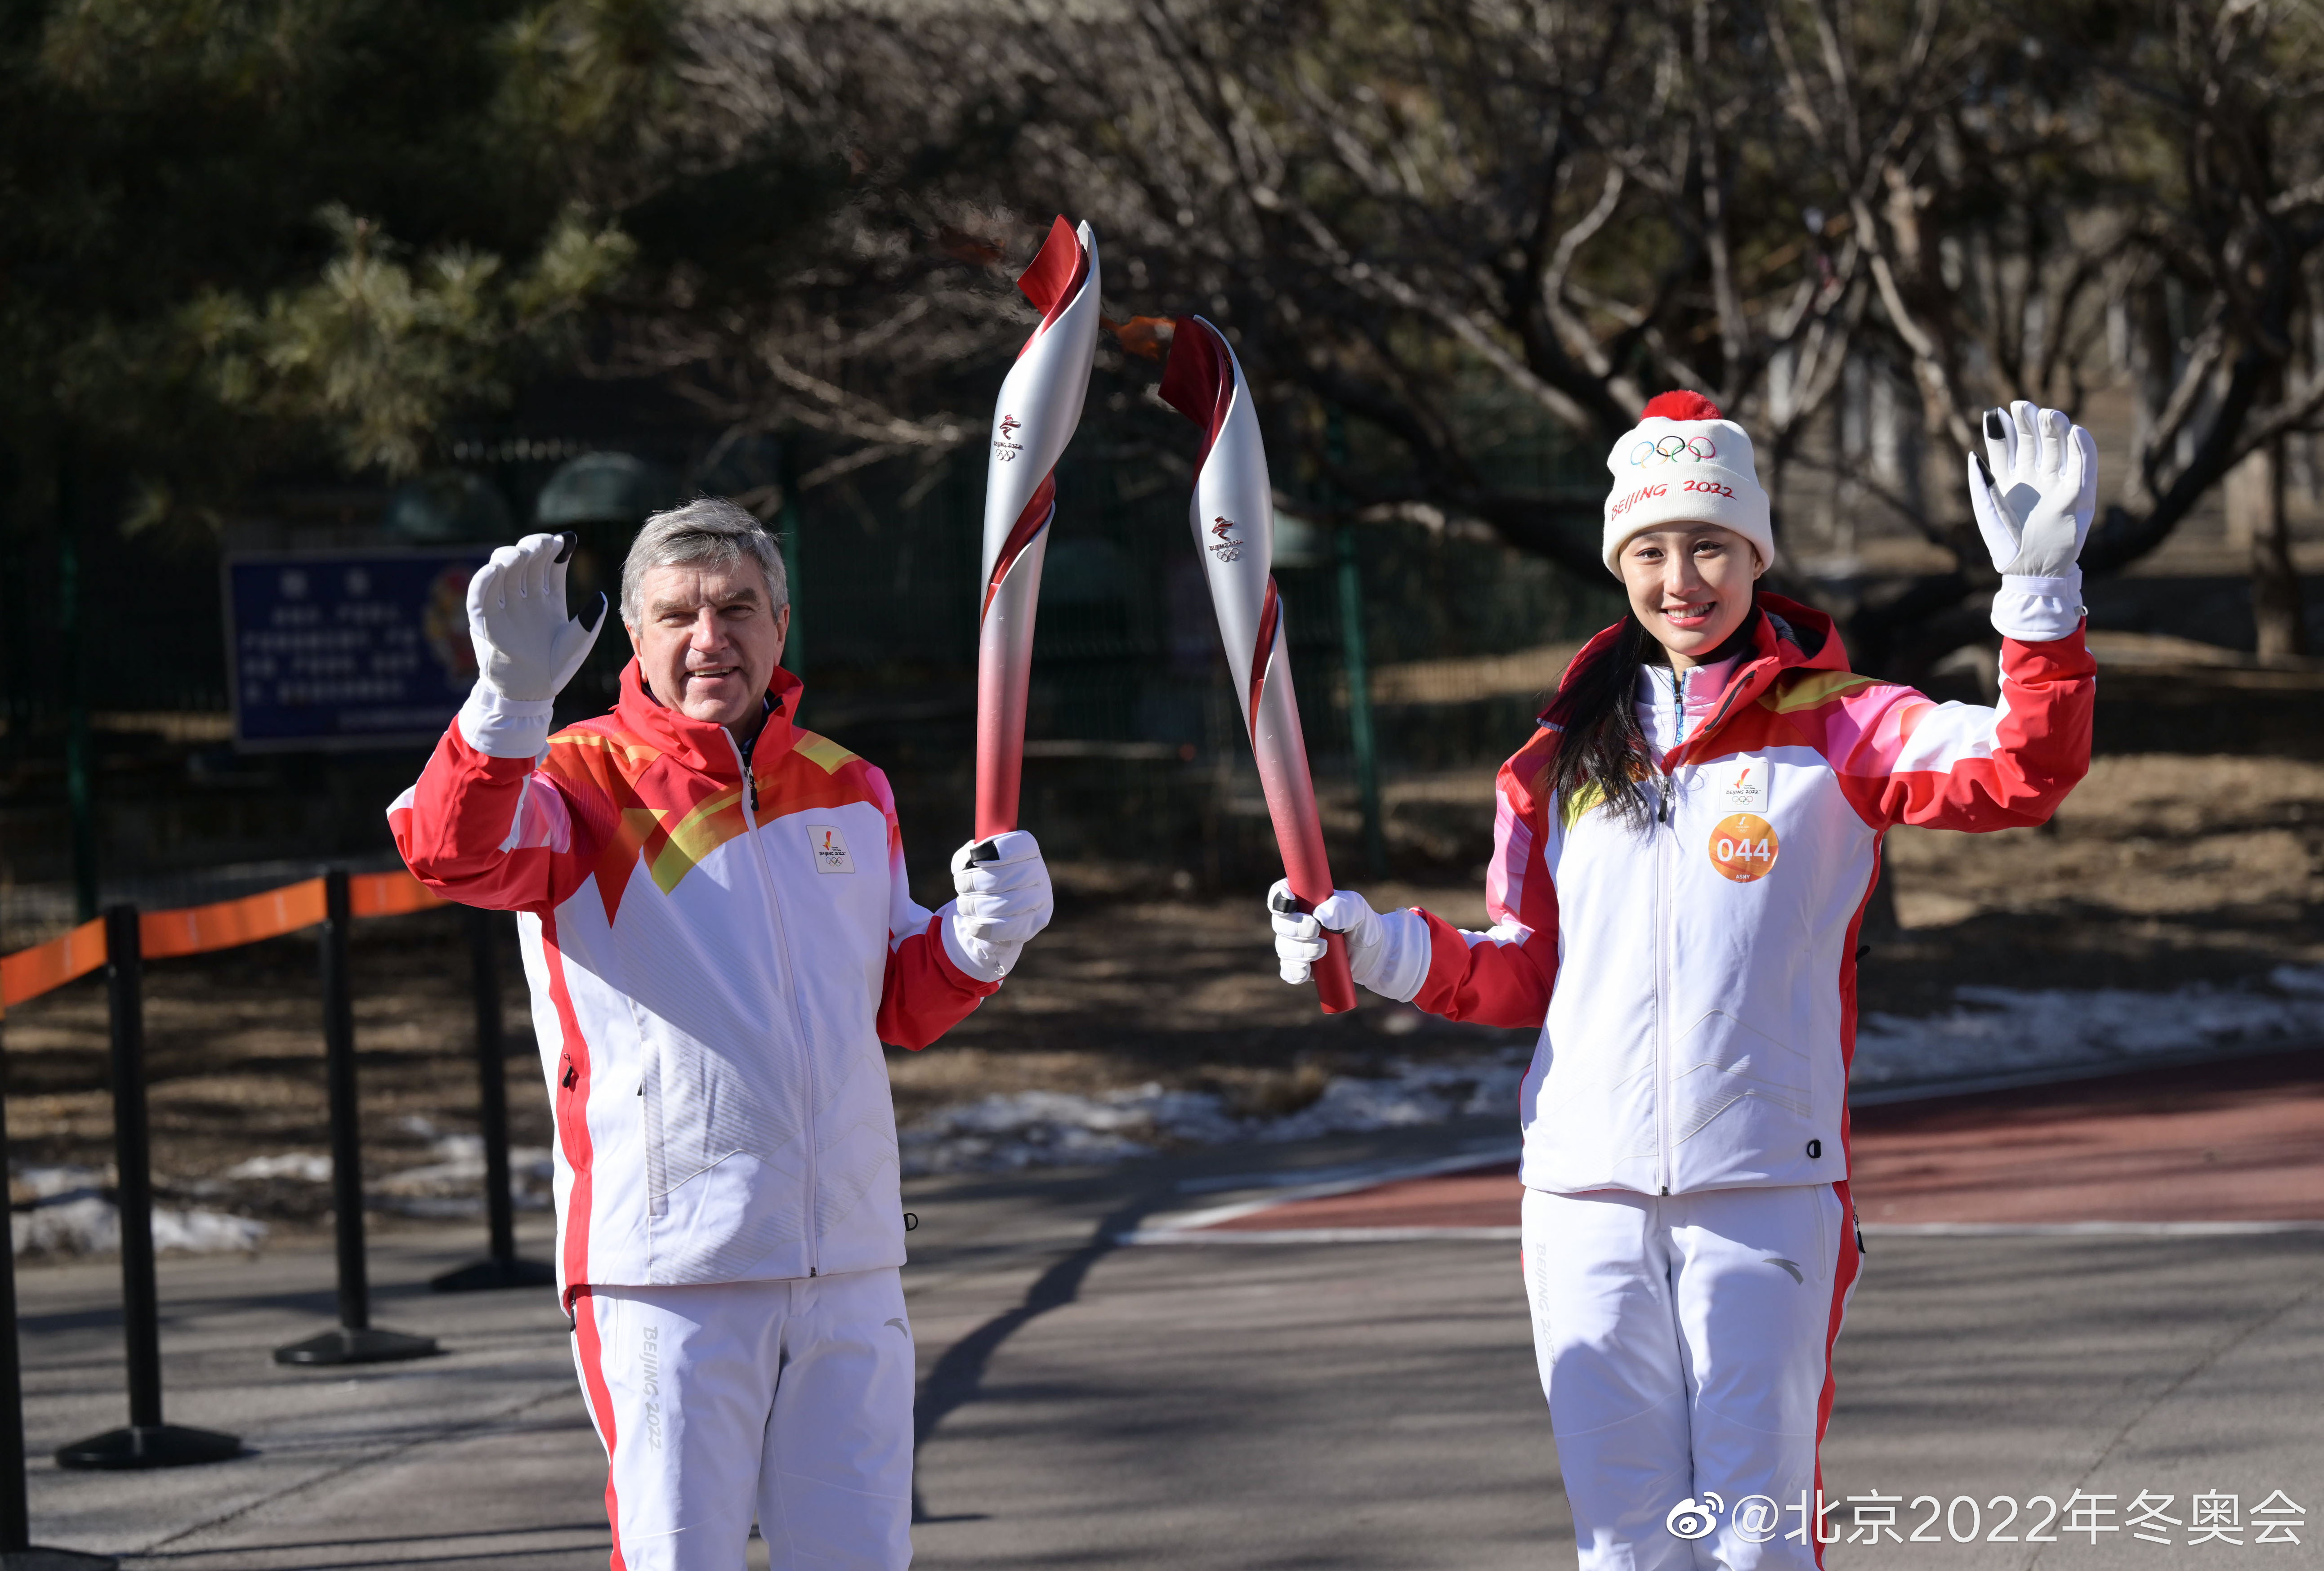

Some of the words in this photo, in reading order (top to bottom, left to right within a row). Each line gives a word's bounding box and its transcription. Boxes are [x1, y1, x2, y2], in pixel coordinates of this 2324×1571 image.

[1612, 484, 1668, 521] BEIJING
[1684, 480, 1737, 501] 2022
[1716, 838, 1771, 862] 044
[1535, 1242, 1550, 1312] BEIJING
[639, 1326, 659, 1396] BEIJING
[1541, 1318, 1556, 1368] 2022
[645, 1401, 662, 1454] 2022
